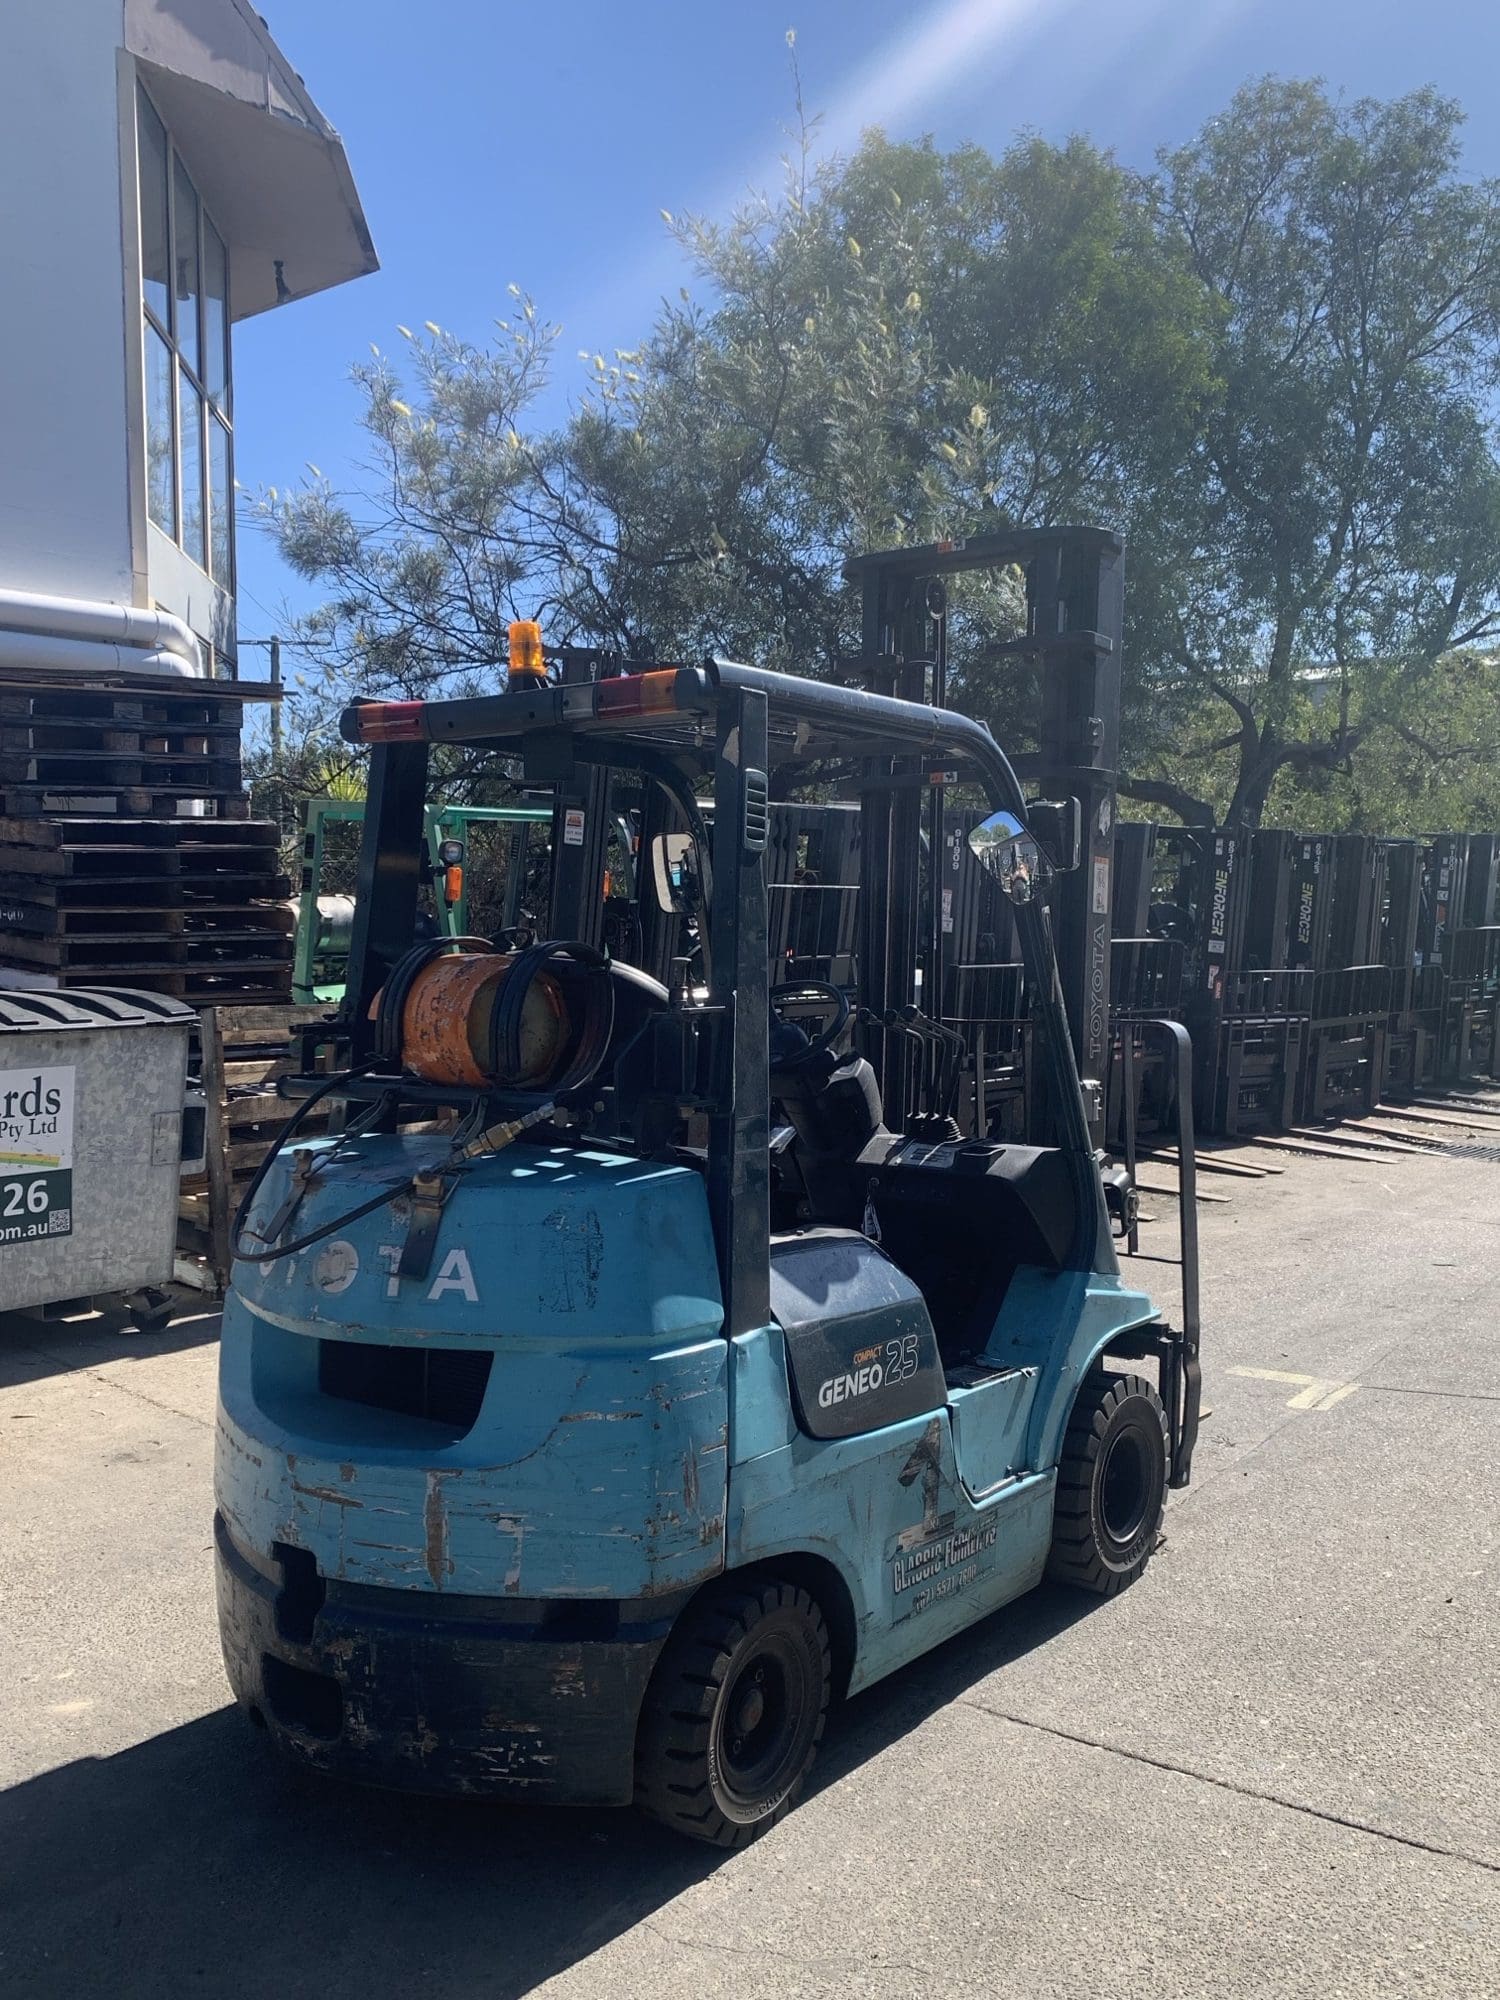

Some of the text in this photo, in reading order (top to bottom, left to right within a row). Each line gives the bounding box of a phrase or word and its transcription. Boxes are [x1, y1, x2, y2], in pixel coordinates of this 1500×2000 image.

[1211, 870, 1228, 936] ENFORCER
[1298, 882, 1314, 944] ENFORCER
[1089, 924, 1106, 1059] TOYOTA
[0, 1075, 62, 1119] rds
[0, 1116, 57, 1143] Pty Ltd
[3, 1179, 49, 1217] 26
[818, 1334, 919, 1408] GENEO 25
[853, 1345, 883, 1365] COMPACT
